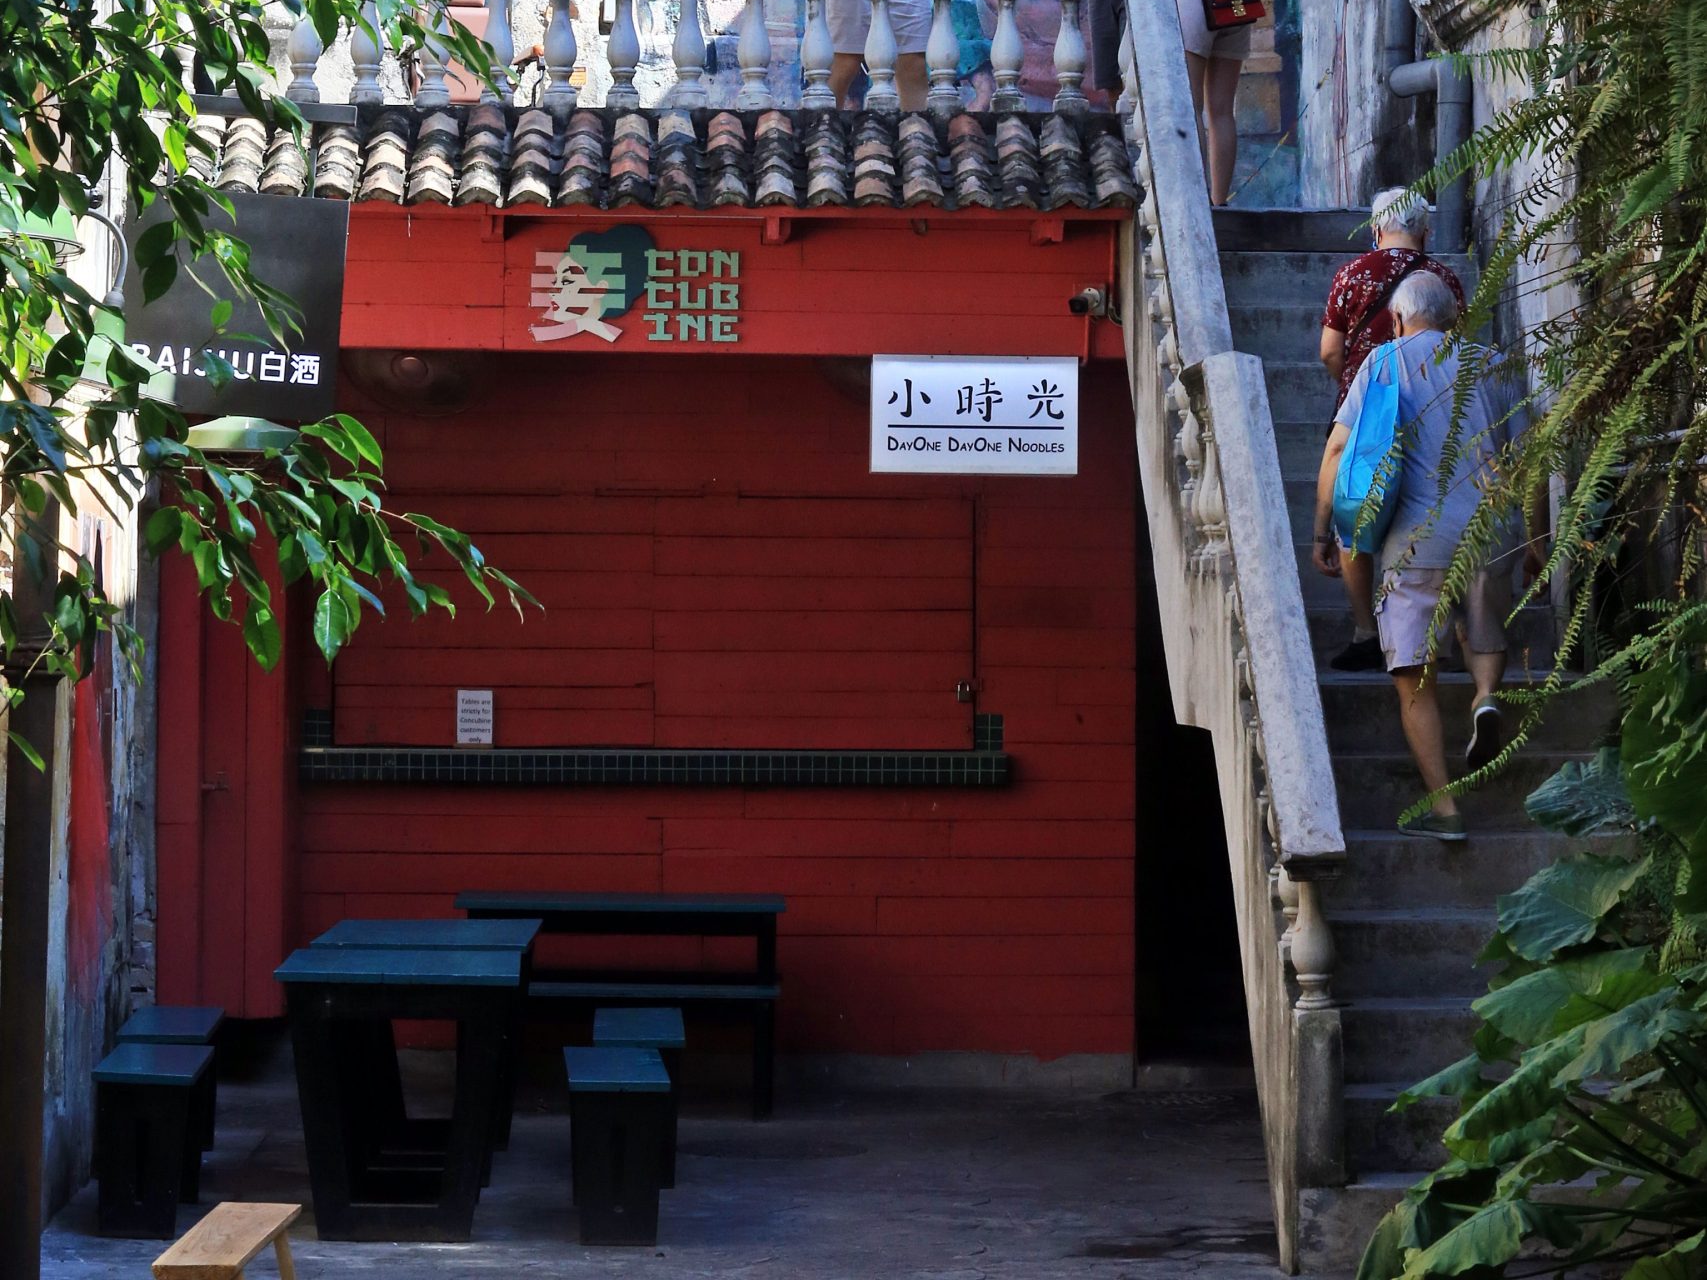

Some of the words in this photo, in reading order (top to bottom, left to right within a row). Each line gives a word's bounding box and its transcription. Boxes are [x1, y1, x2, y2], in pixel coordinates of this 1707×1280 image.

[644, 248, 739, 278] CON
[643, 312, 738, 342] INE
[888, 377, 1065, 423] 小時光
